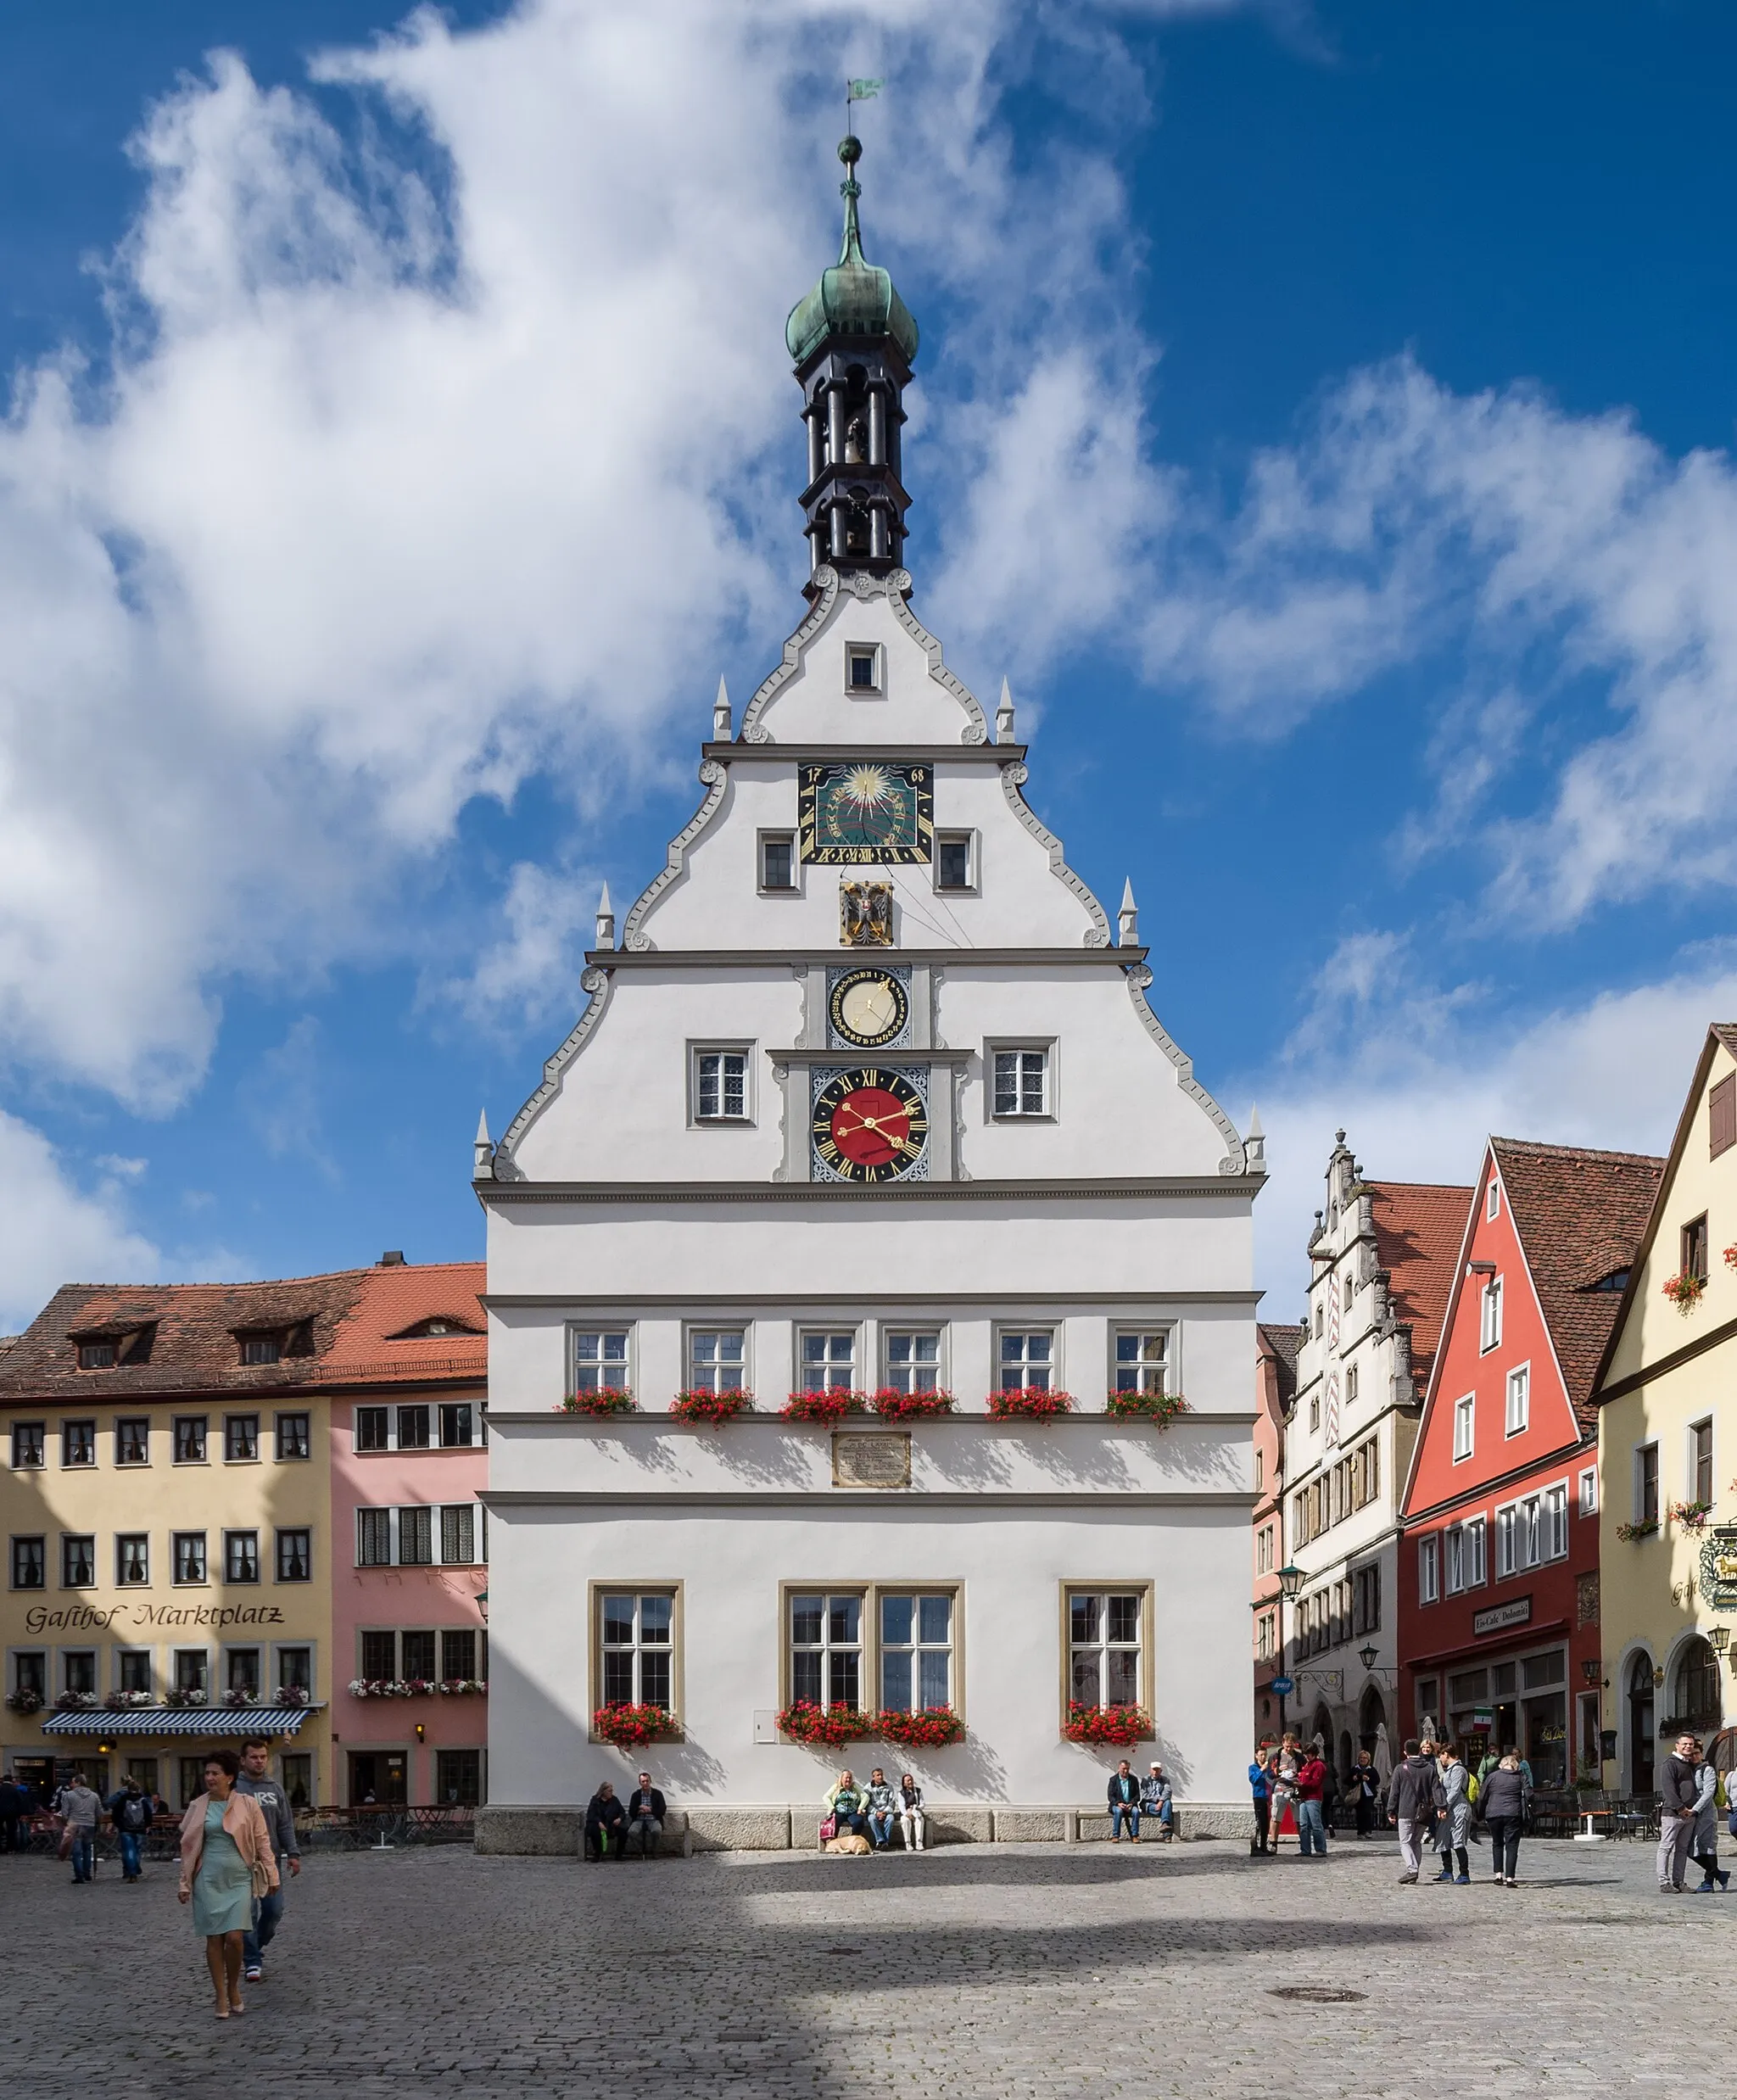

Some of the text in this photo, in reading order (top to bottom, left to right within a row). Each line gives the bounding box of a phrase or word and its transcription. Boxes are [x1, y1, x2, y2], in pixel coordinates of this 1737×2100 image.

[807, 768, 924, 782] 17 68
[837, 1075, 854, 1094] XI
[862, 1070, 877, 1086] XII
[889, 1075, 899, 1092] I
[819, 1095, 837, 1109] X
[902, 1095, 920, 1107] II
[813, 1120, 830, 1132] IX
[909, 1120, 927, 1131] III
[818, 1139, 839, 1162] VIII
[902, 1141, 923, 1160] IIII
[837, 1158, 854, 1178] VII
[866, 1165, 877, 1181] VI
[890, 1160, 901, 1176] V
[132, 1603, 285, 1628] Marktplatz
